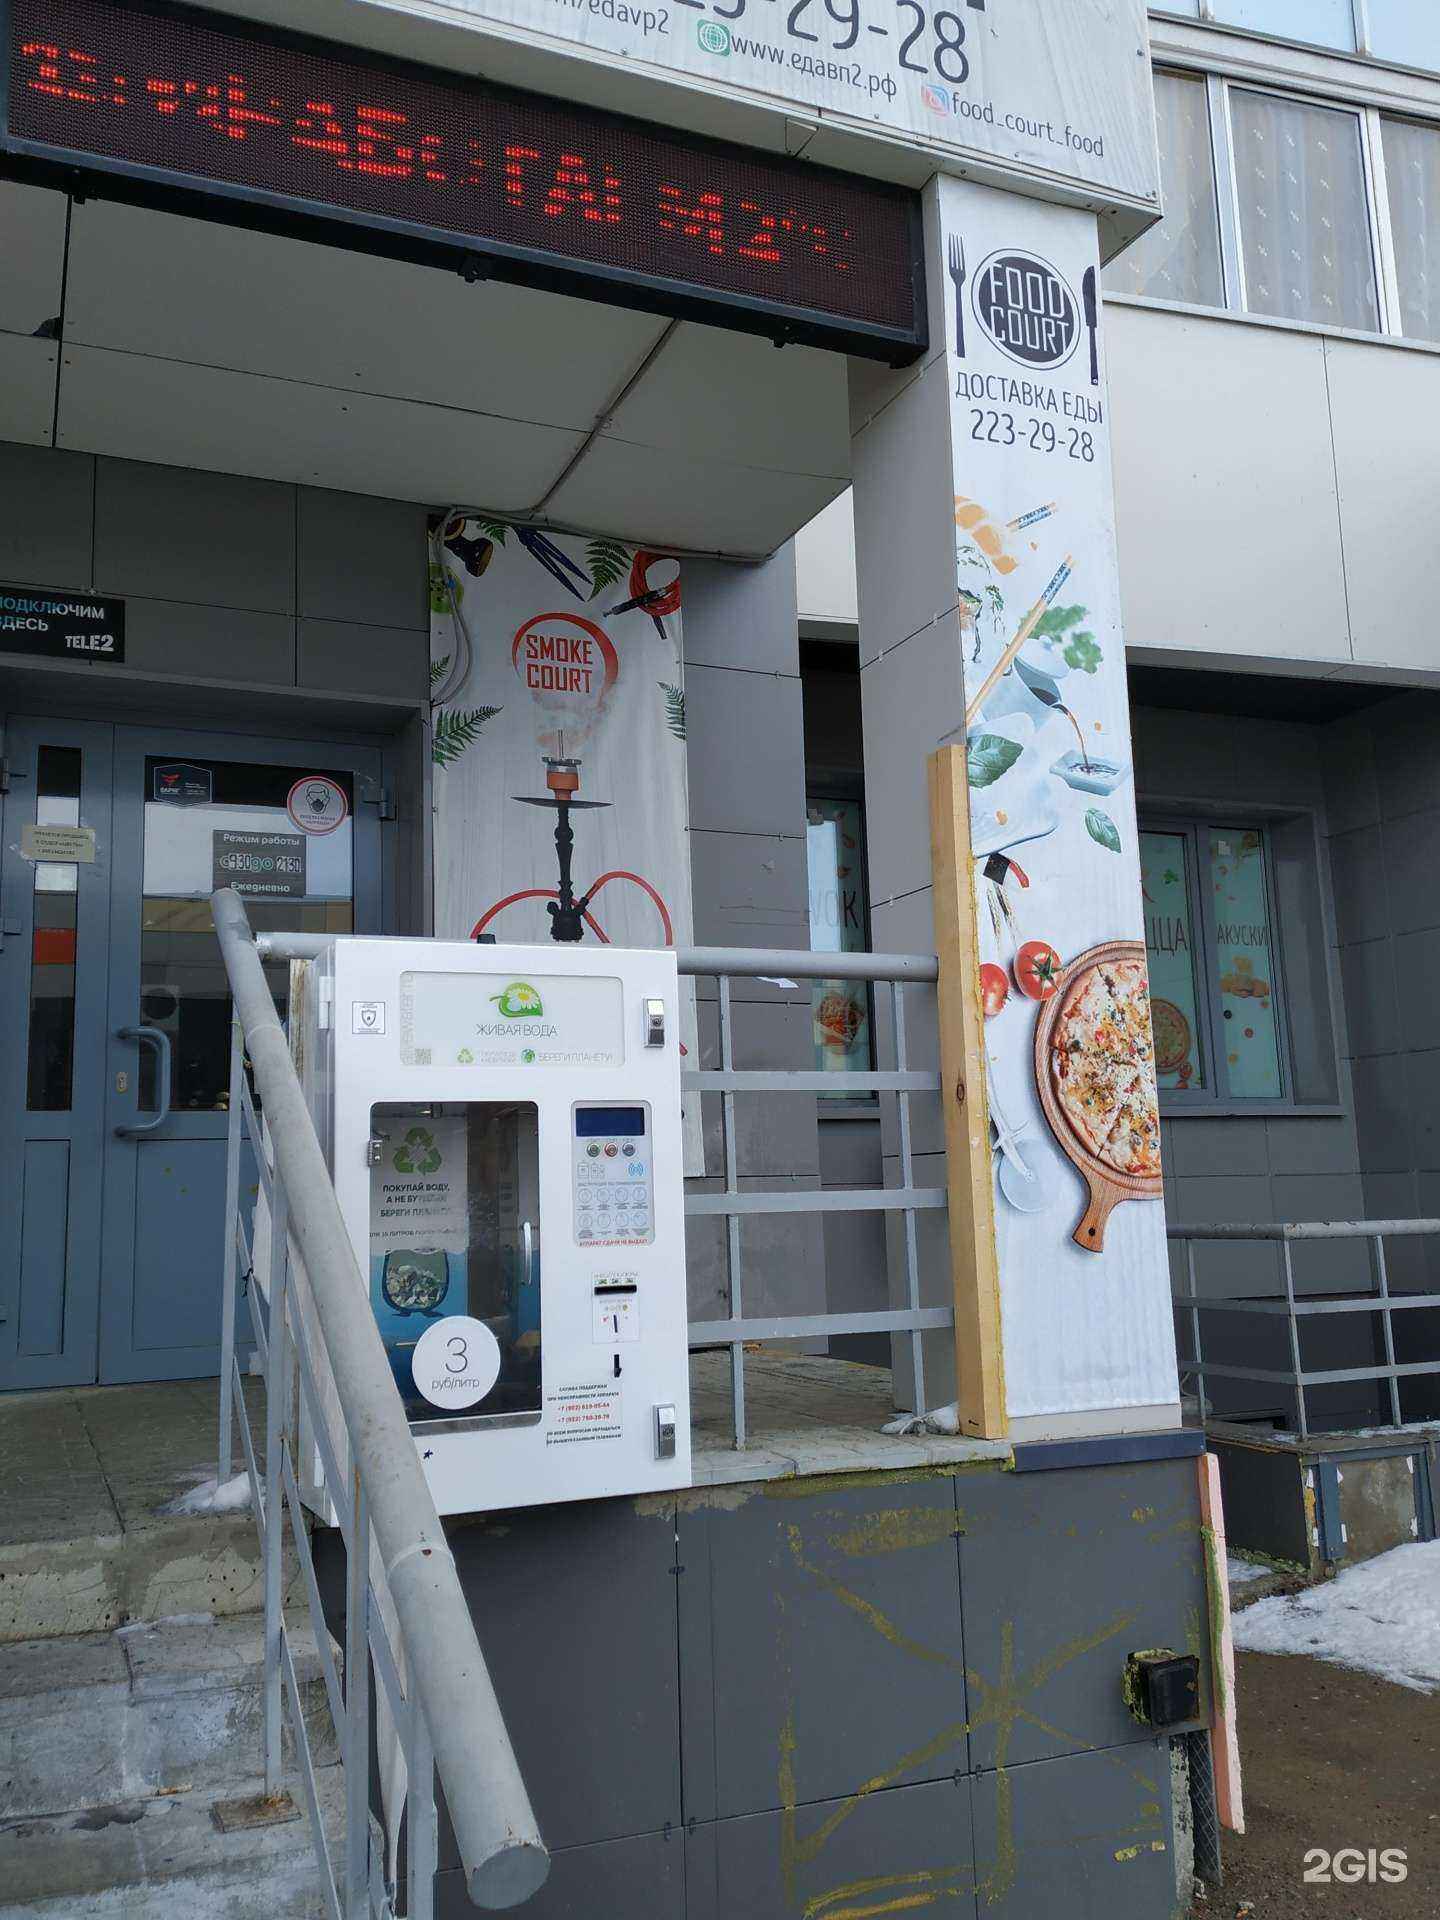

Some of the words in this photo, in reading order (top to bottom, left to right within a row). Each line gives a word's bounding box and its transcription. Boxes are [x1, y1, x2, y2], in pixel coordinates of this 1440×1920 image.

[731, 36, 897, 102] www.едавп2.рф
[952, 91, 1105, 160] food_court_food
[989, 261, 1065, 319] FOOD
[989, 305, 1070, 354] COURT
[955, 371, 1059, 414] ДОСТАВКА
[1062, 391, 1103, 424] ЕДЫ
[970, 408, 1095, 463] 223-29-28
[64, 634, 115, 652] TELE2
[525, 634, 594, 665] SMOKE
[526, 663, 593, 694] COURT
[223, 833, 258, 844] Режим
[262, 836, 299, 845] работы
[231, 881, 290, 893] Ежедневно
[1216, 922, 1269, 946] АКУСКИ
[477, 1024, 522, 1037] ЖИВАЯ
[523, 1024, 558, 1038] ВОДА
[382, 1182, 424, 1193] ПОКУПАЙ
[394, 1196, 407, 1204] НЕ
[445, 1336, 468, 1373] 3
[431, 1376, 480, 1393] руб/литр
